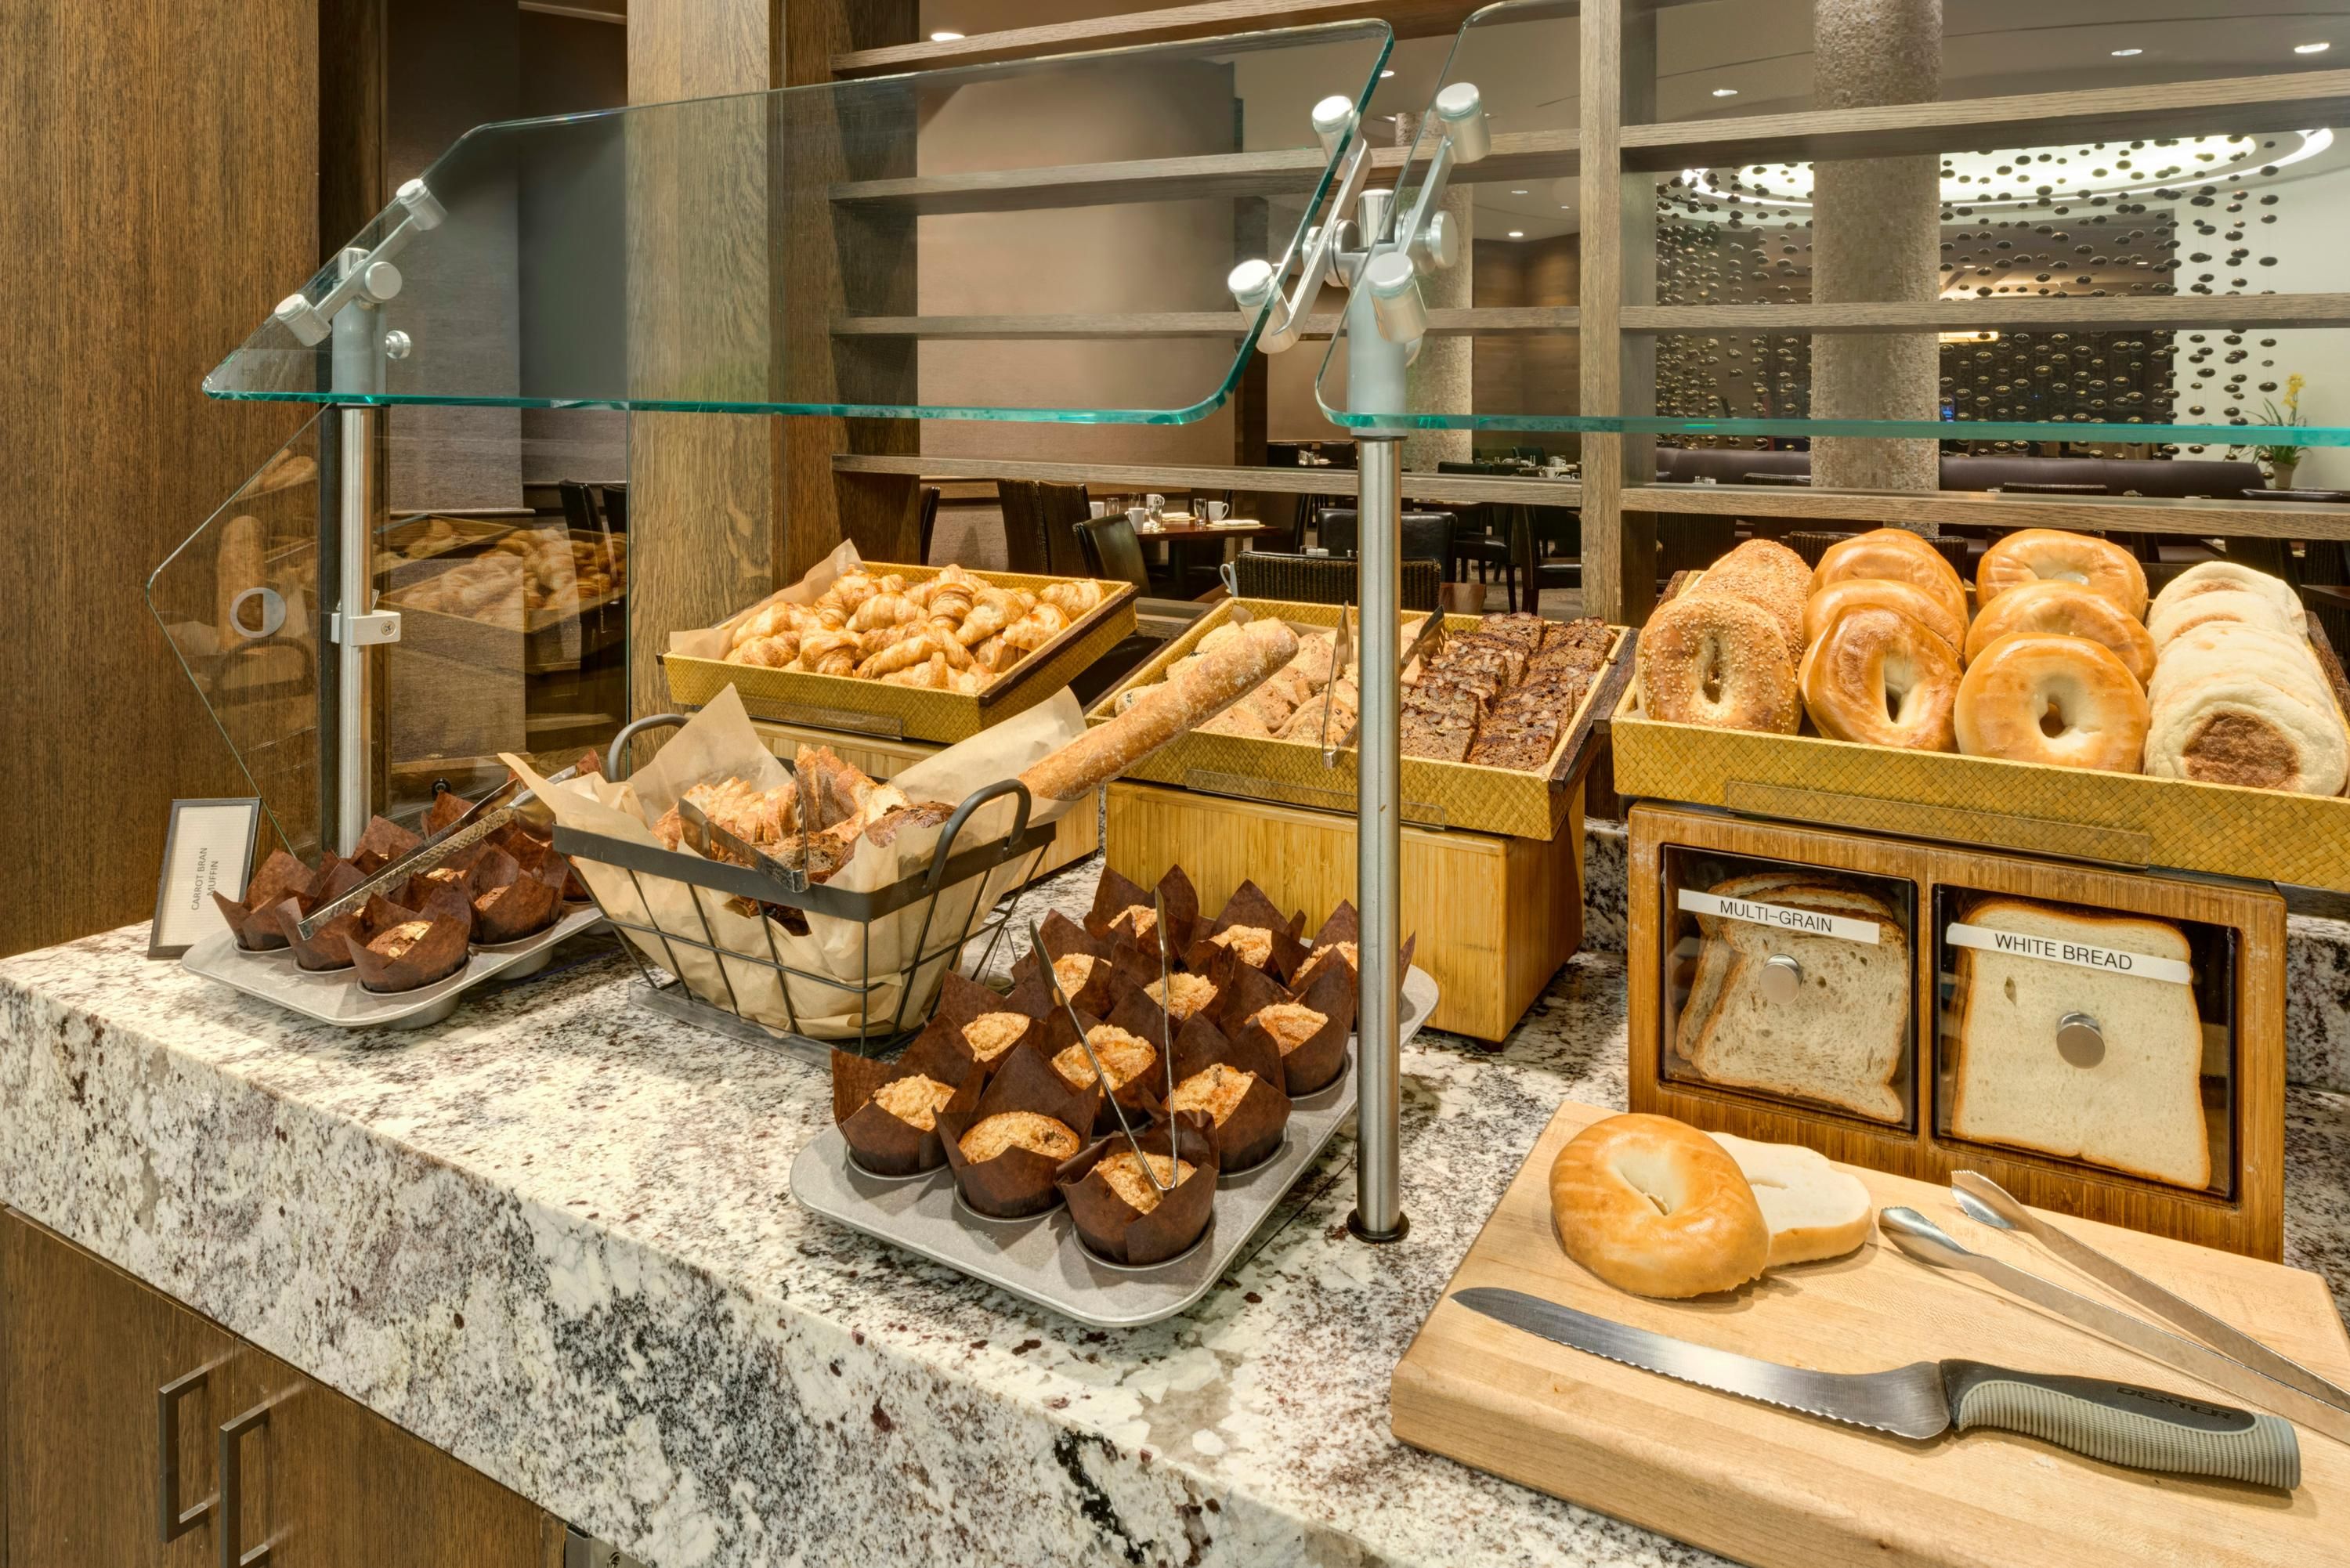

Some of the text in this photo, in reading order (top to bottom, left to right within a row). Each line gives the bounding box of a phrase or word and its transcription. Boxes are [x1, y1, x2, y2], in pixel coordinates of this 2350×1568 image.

[191, 847, 208, 910] CARROT BRAN
[206, 861, 219, 896] MUFFIN
[1720, 900, 1831, 932] MULTI-GRAIN
[1995, 933, 2132, 970] WHITE BREAD
[2117, 1386, 2232, 1419] DEXTER
